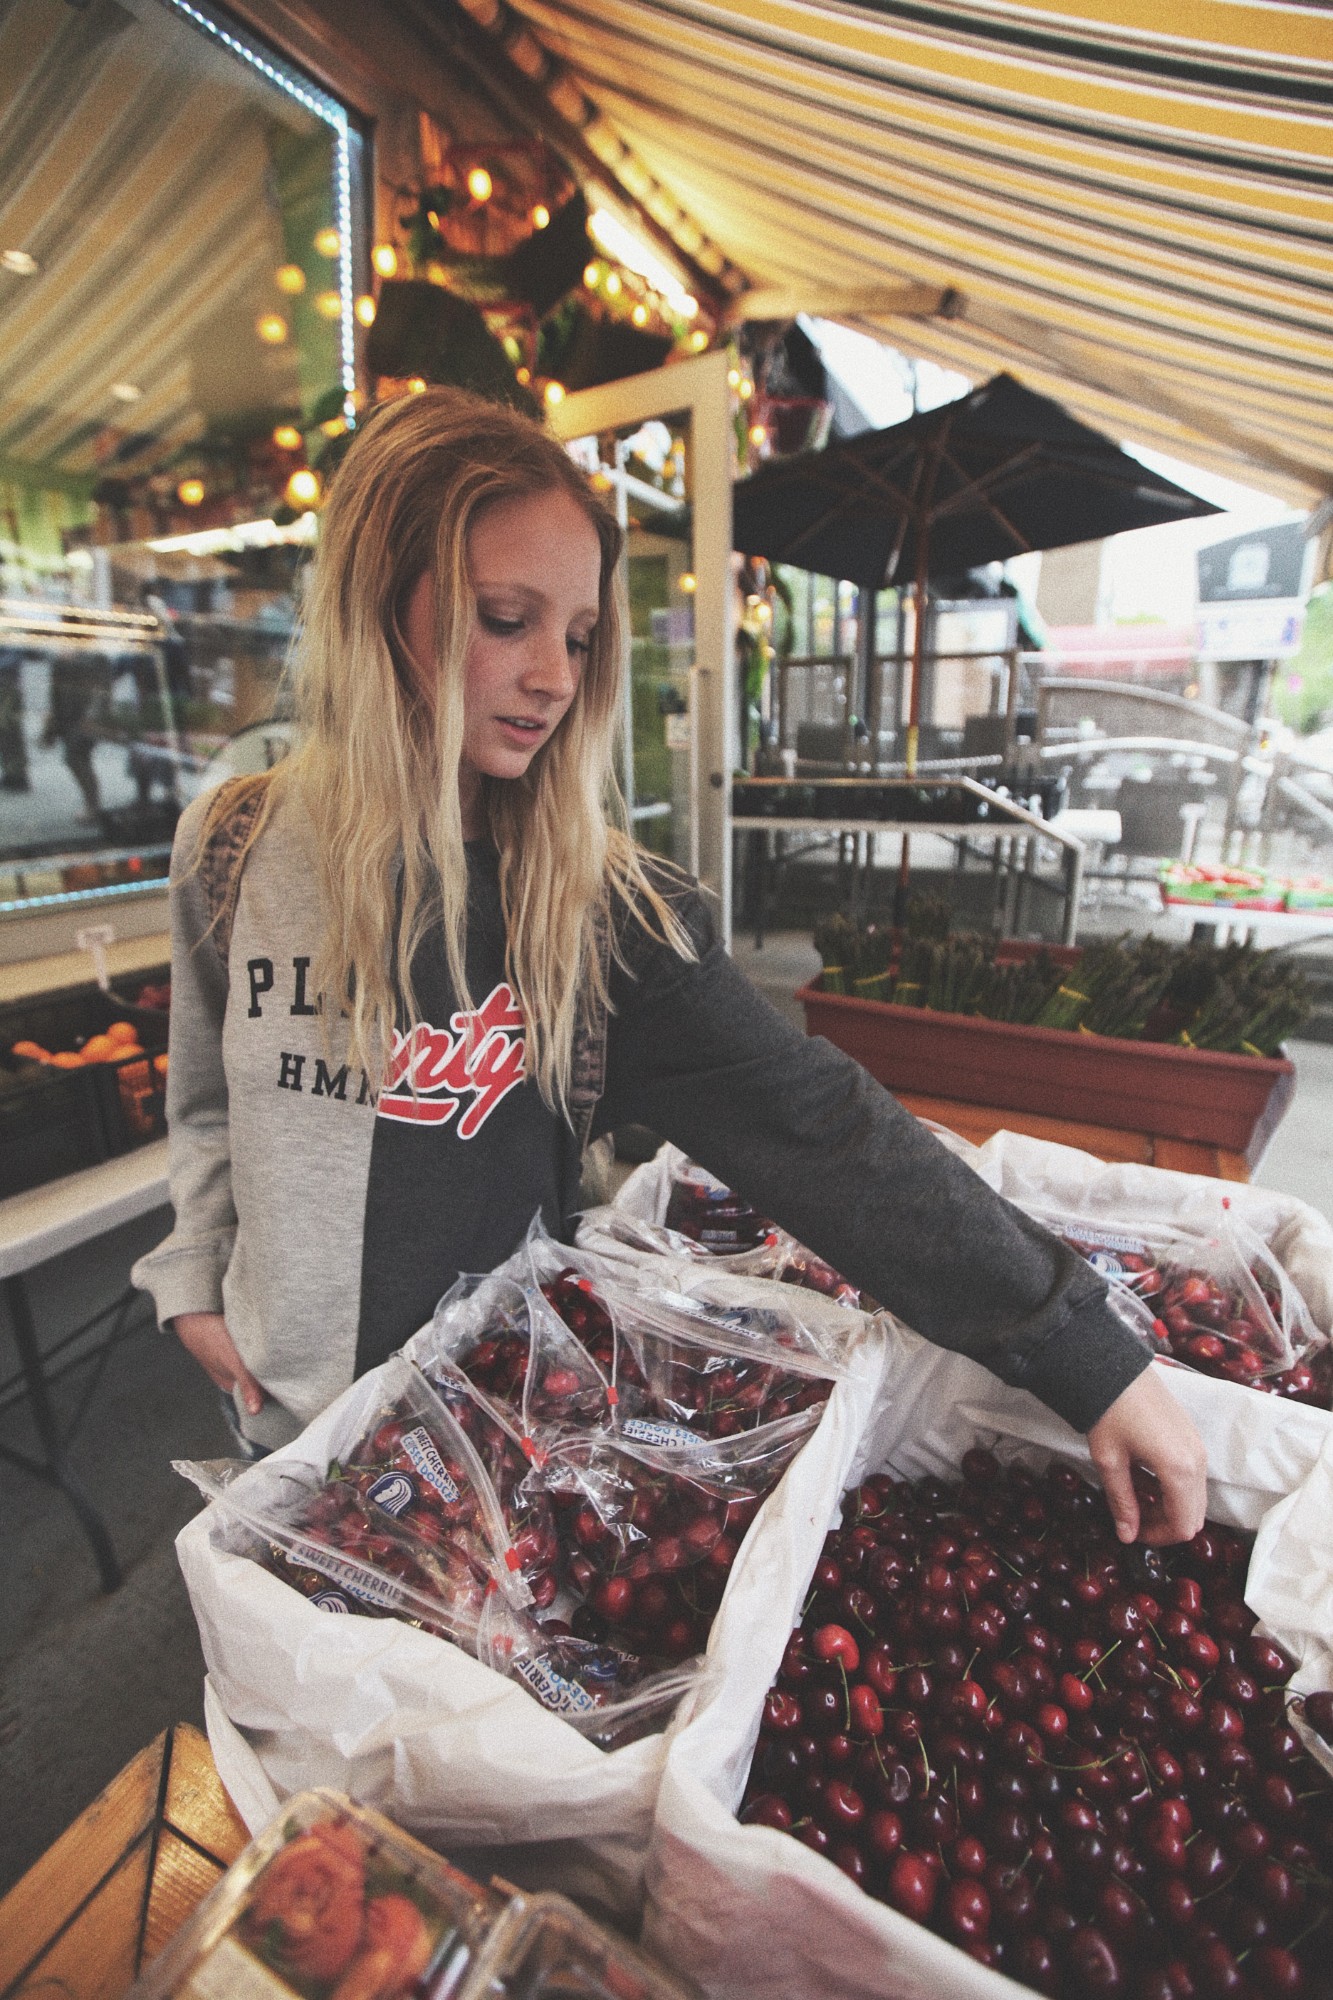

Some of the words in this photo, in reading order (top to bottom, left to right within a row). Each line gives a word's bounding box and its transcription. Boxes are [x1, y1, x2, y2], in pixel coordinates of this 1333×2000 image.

[413, 1427, 435, 1453] SWEET
[299, 1545, 340, 1574] SWEET
[343, 1566, 403, 1600] CHERRIE
